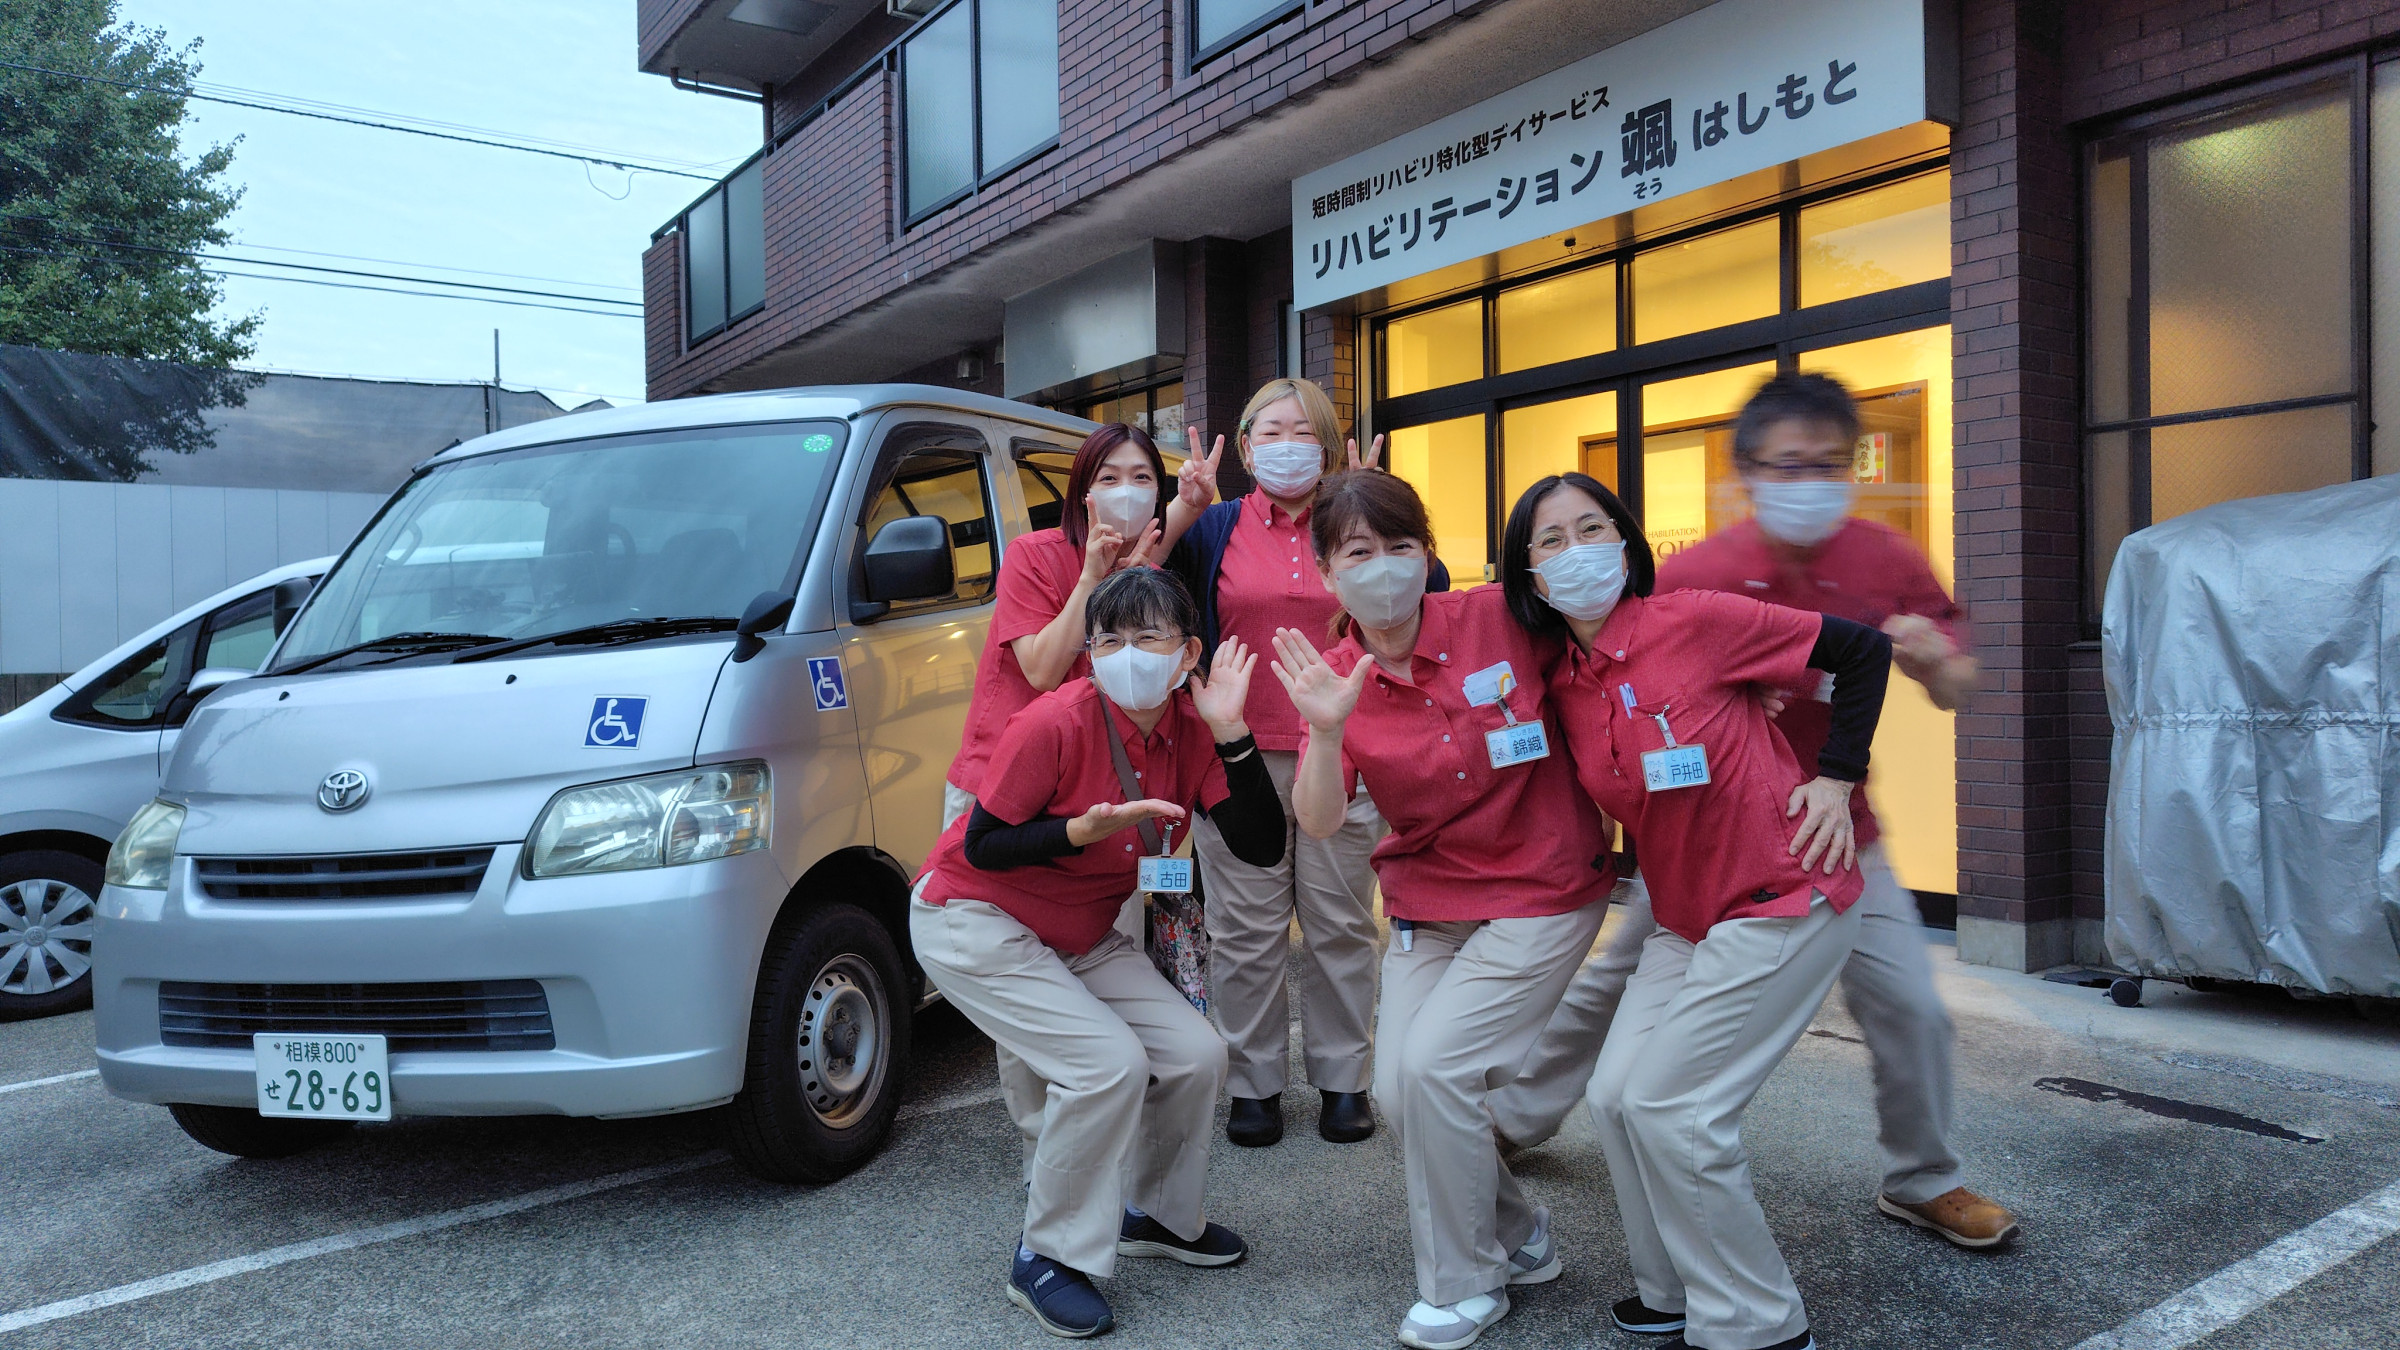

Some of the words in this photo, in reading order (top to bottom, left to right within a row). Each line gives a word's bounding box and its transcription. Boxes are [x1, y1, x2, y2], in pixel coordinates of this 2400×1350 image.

[1312, 86, 1610, 219] 短時間制リハビリ特化型デイサービス
[1312, 150, 1604, 280] リハビリテーション
[1621, 98, 1677, 179] 颯
[1693, 59, 1857, 152] はしもと
[1633, 177, 1663, 199] そう
[1670, 761, 1704, 783] 戸井田
[1160, 871, 1187, 888] 古田
[264, 1079, 281, 1100] せ
[285, 1069, 382, 1113] 28-69
[1033, 1269, 1055, 1290] PUMA
